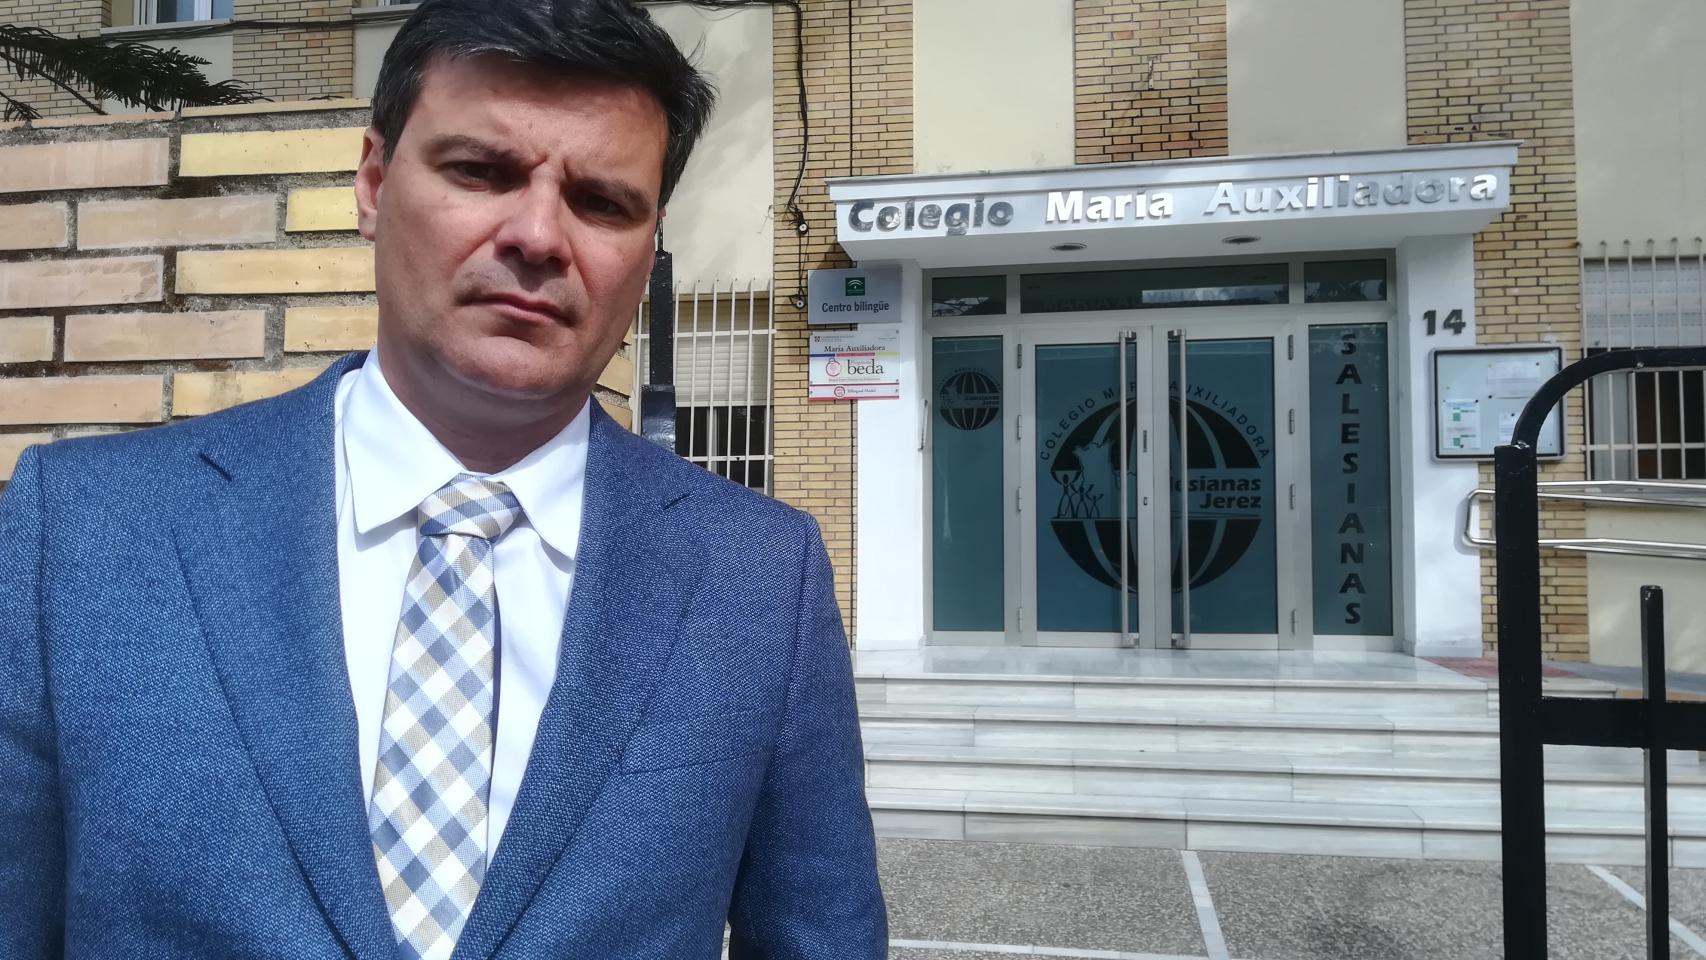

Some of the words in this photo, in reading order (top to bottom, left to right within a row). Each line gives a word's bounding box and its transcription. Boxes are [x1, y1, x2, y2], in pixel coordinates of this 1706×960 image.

[849, 196, 1014, 237] Colegio
[1203, 172, 1498, 215] Auxiliadora
[822, 302, 852, 313] Centro
[854, 301, 890, 314] bilingüe
[1423, 309, 1467, 336] 14
[846, 344, 886, 352] Auxiliadora
[847, 358, 884, 375] beda
[1040, 398, 1096, 461] COLEGIO
[1170, 475, 1262, 492] lesianas
[1335, 333, 1366, 625] SALESIANAS
[1200, 493, 1262, 509] Jerez
